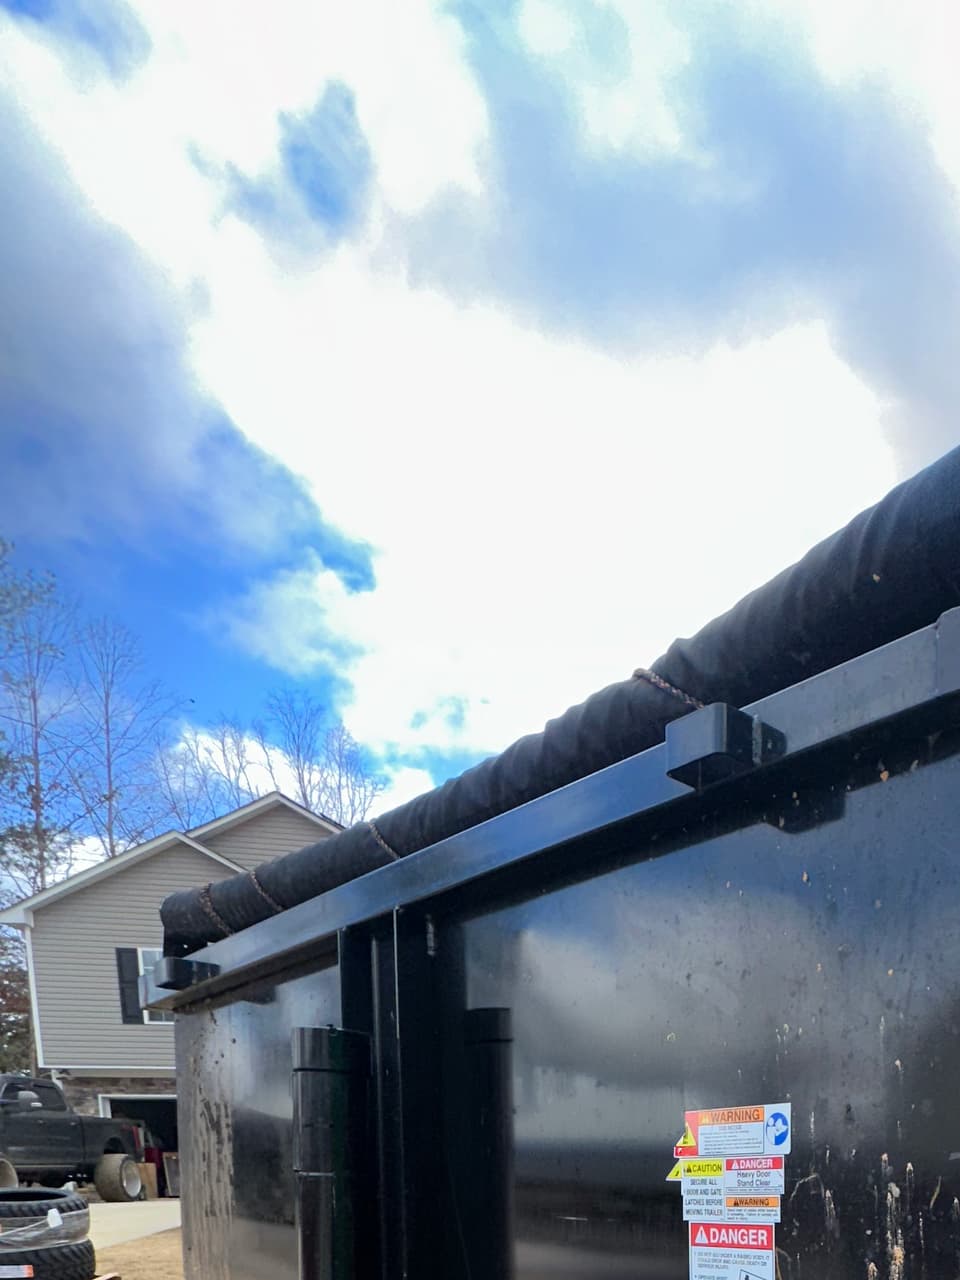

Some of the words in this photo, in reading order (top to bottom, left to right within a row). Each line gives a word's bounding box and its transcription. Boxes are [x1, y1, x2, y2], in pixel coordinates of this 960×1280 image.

[710, 1109, 760, 1122] WARNING
[692, 1163, 722, 1173] CAUTION
[740, 1159, 773, 1169] DANGER
[737, 1170, 755, 1178] Heavy
[709, 1227, 768, 1246] DANGER
